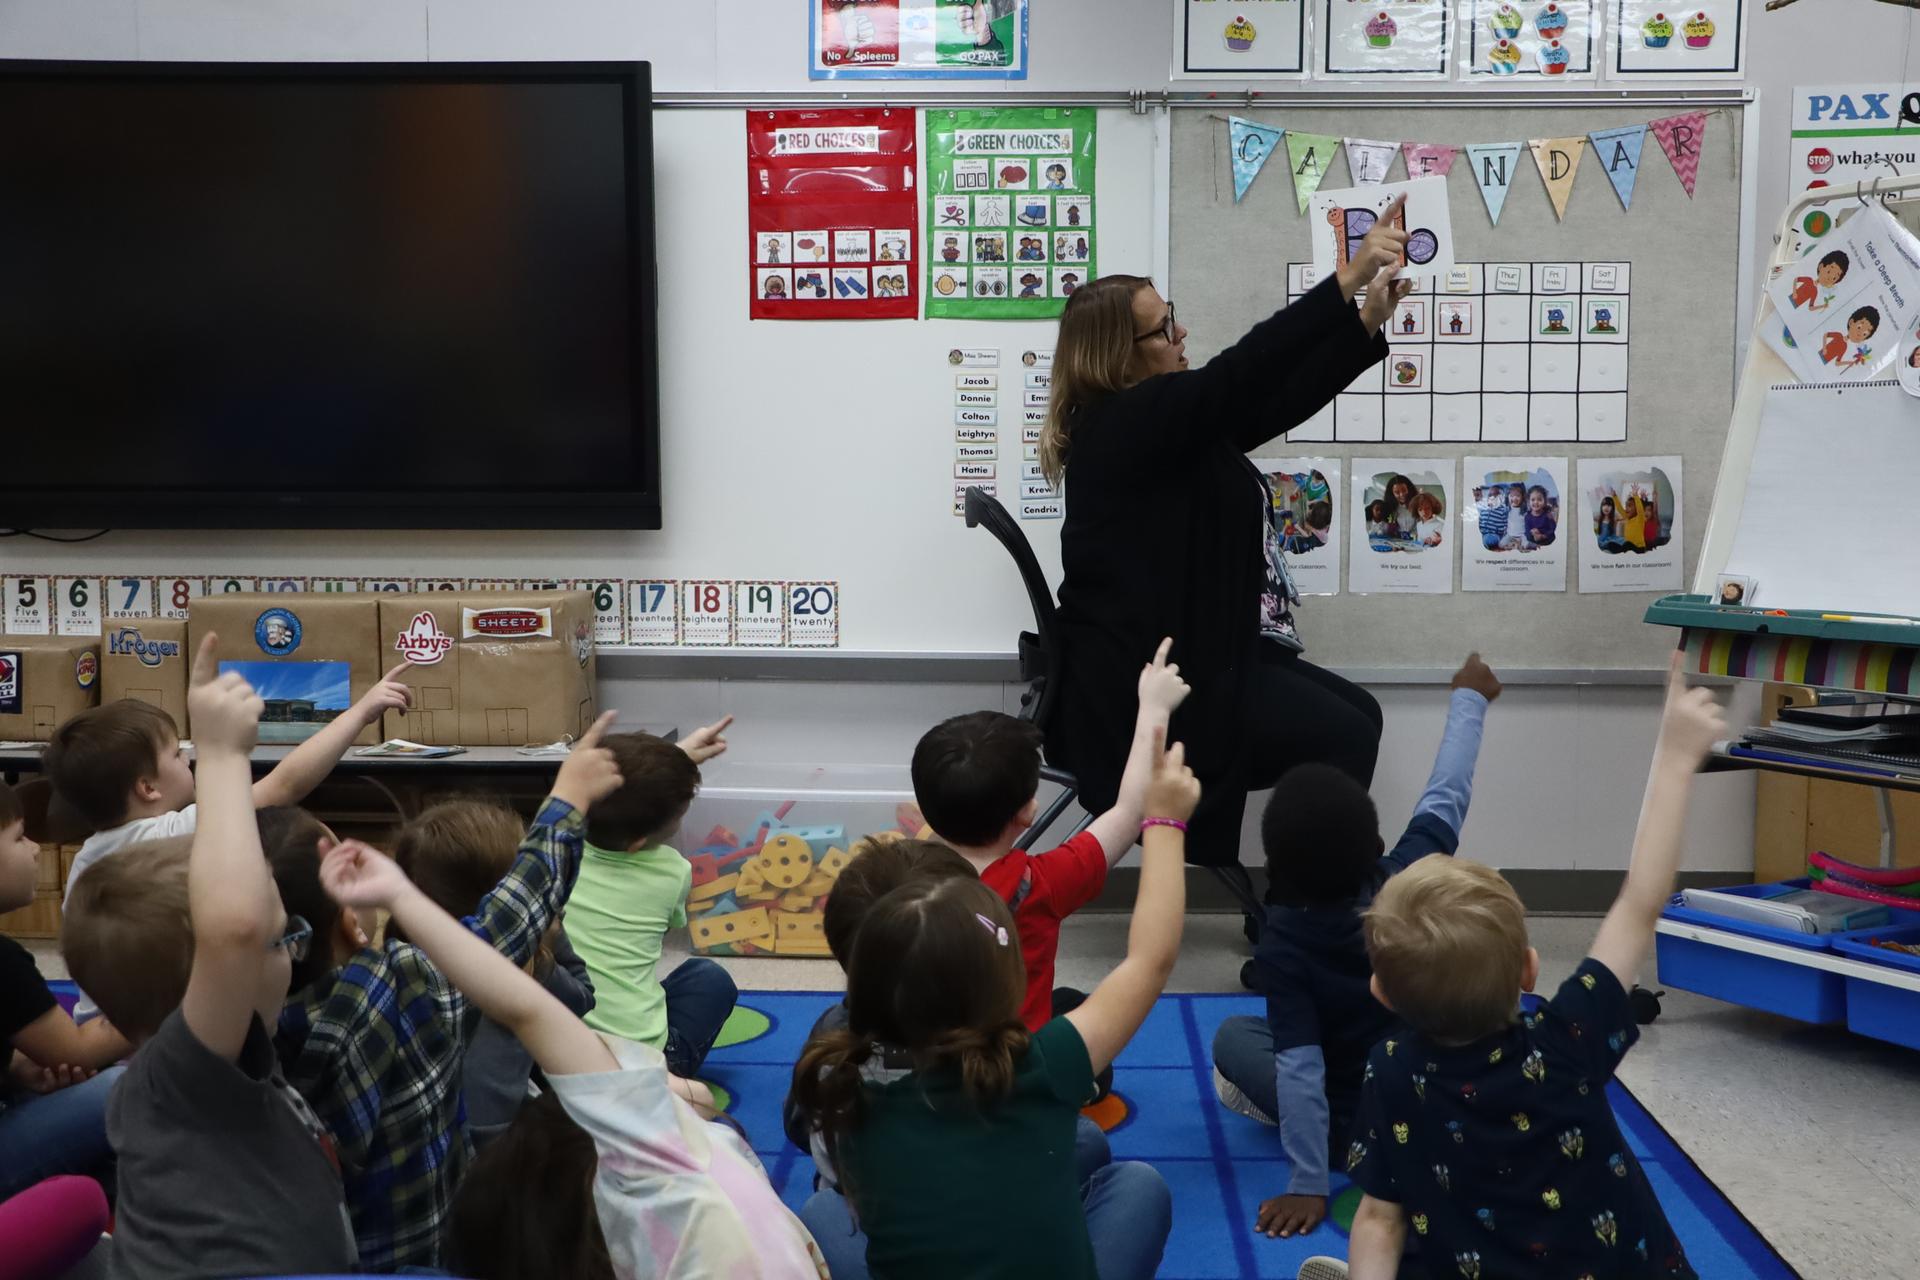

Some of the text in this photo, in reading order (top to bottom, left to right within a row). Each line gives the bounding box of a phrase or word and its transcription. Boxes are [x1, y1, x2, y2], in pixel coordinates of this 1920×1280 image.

[827, 51, 896, 62] No Spleems
[960, 51, 999, 61] GO PAX
[1808, 94, 1890, 121] PAX
[789, 133, 866, 148] RED CHOICES
[967, 134, 1060, 150] GREEN CHOICES
[1808, 151, 1916, 168] STOP what you
[1451, 271, 1466, 279] Wed
[1598, 270, 1611, 279] Sat
[1865, 240, 1877, 260] Take
[1878, 264, 1892, 286] Deep
[1889, 283, 1905, 309] Breath
[1035, 376, 1051, 387] Elij
[960, 394, 991, 402] Donnie
[962, 412, 990, 420] Colton
[958, 430, 995, 439] Leightyn
[18, 579, 37, 608] 5
[69, 579, 88, 608] 6
[121, 580, 141, 610] 7
[172, 580, 190, 609] 8
[640, 585, 666, 613] 17
[694, 585, 720, 613] 18
[749, 585, 772, 613] 19
[792, 587, 833, 615] 20
[15, 606, 39, 616] five
[71, 609, 87, 617] six
[113, 610, 148, 618] seven
[478, 618, 537, 628] SHEETZ
[594, 614, 620, 623] teen
[685, 613, 731, 625] eighteen
[737, 615, 782, 624] nineteen
[793, 617, 834, 628] twenty
[110, 628, 178, 666] Kroger
[397, 633, 452, 653] Arby's
